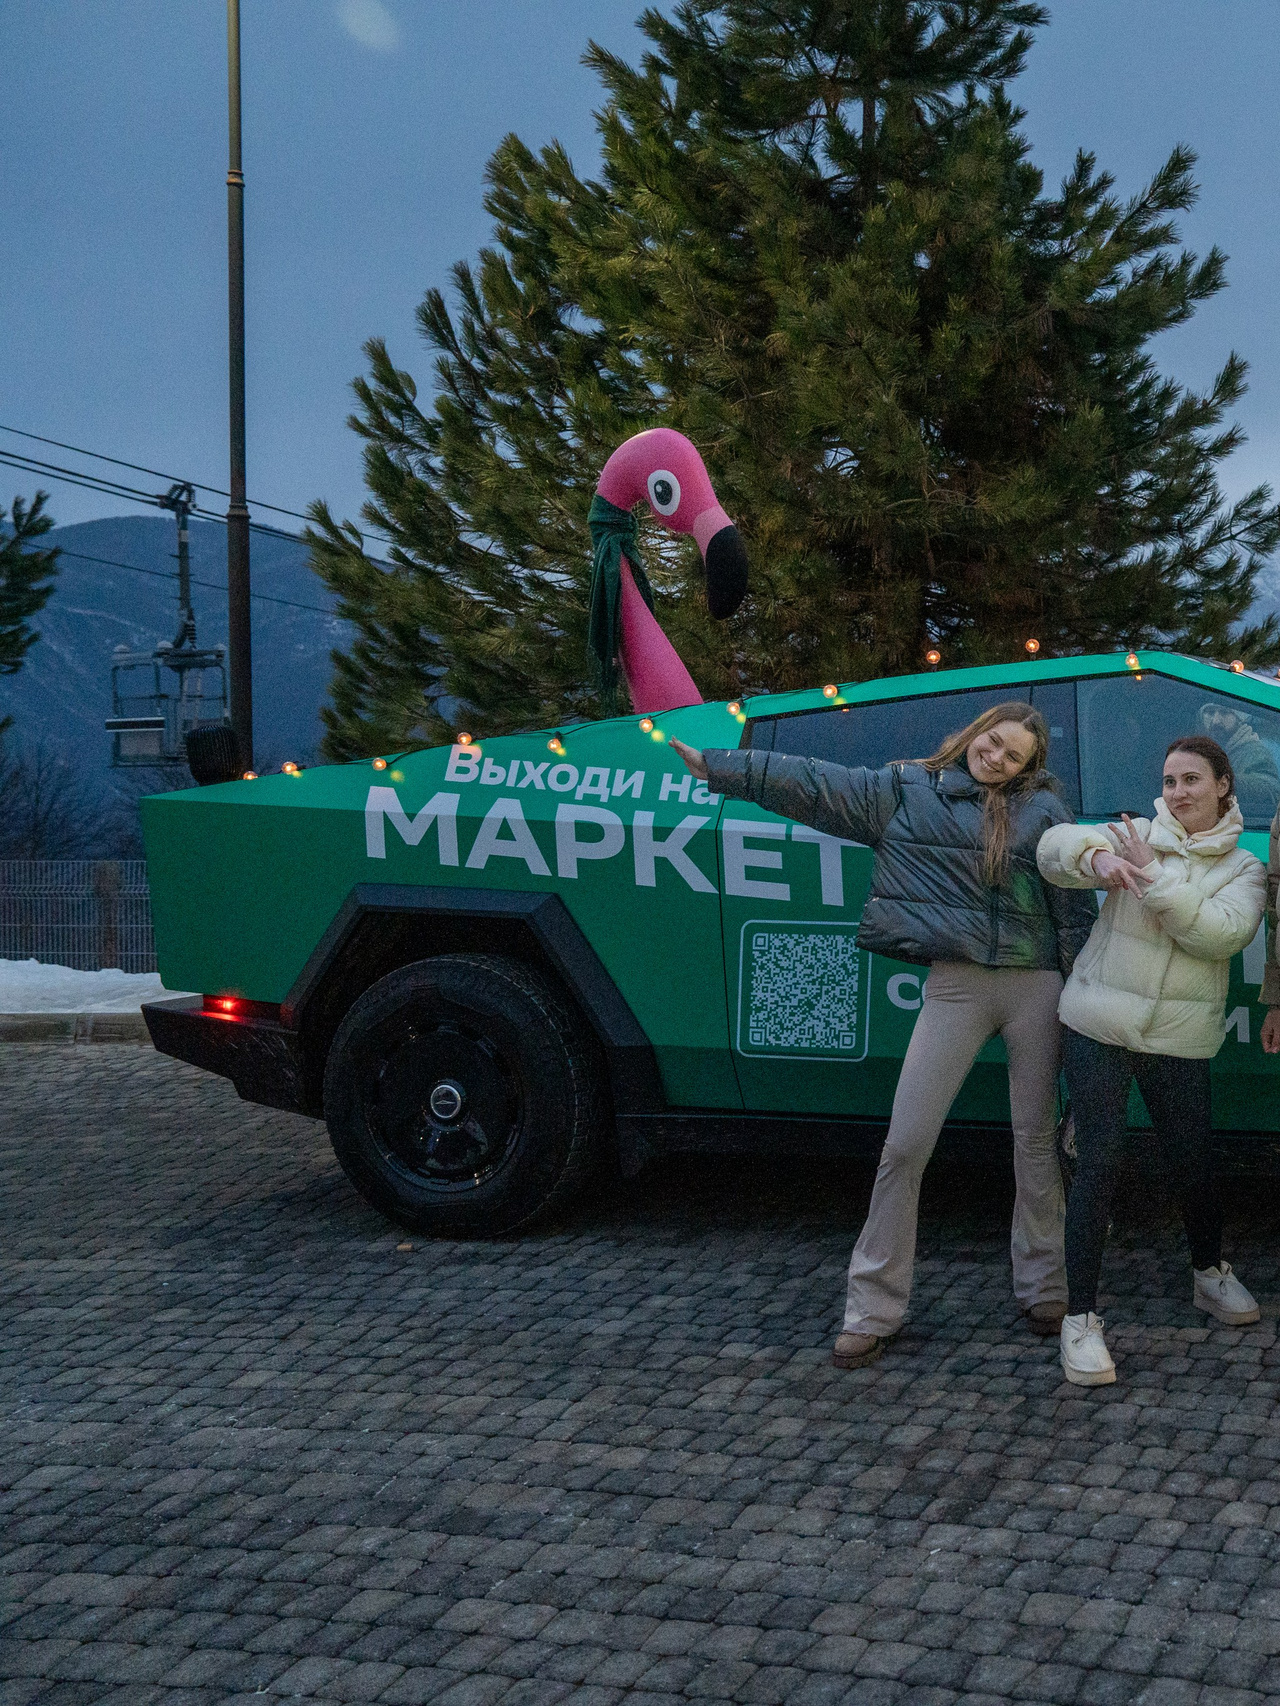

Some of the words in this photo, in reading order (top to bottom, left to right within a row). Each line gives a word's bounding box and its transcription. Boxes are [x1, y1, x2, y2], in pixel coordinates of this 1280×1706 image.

[444, 744, 646, 802] Выходи
[658, 772, 720, 806] на
[364, 785, 871, 907] МАРКЕТ
